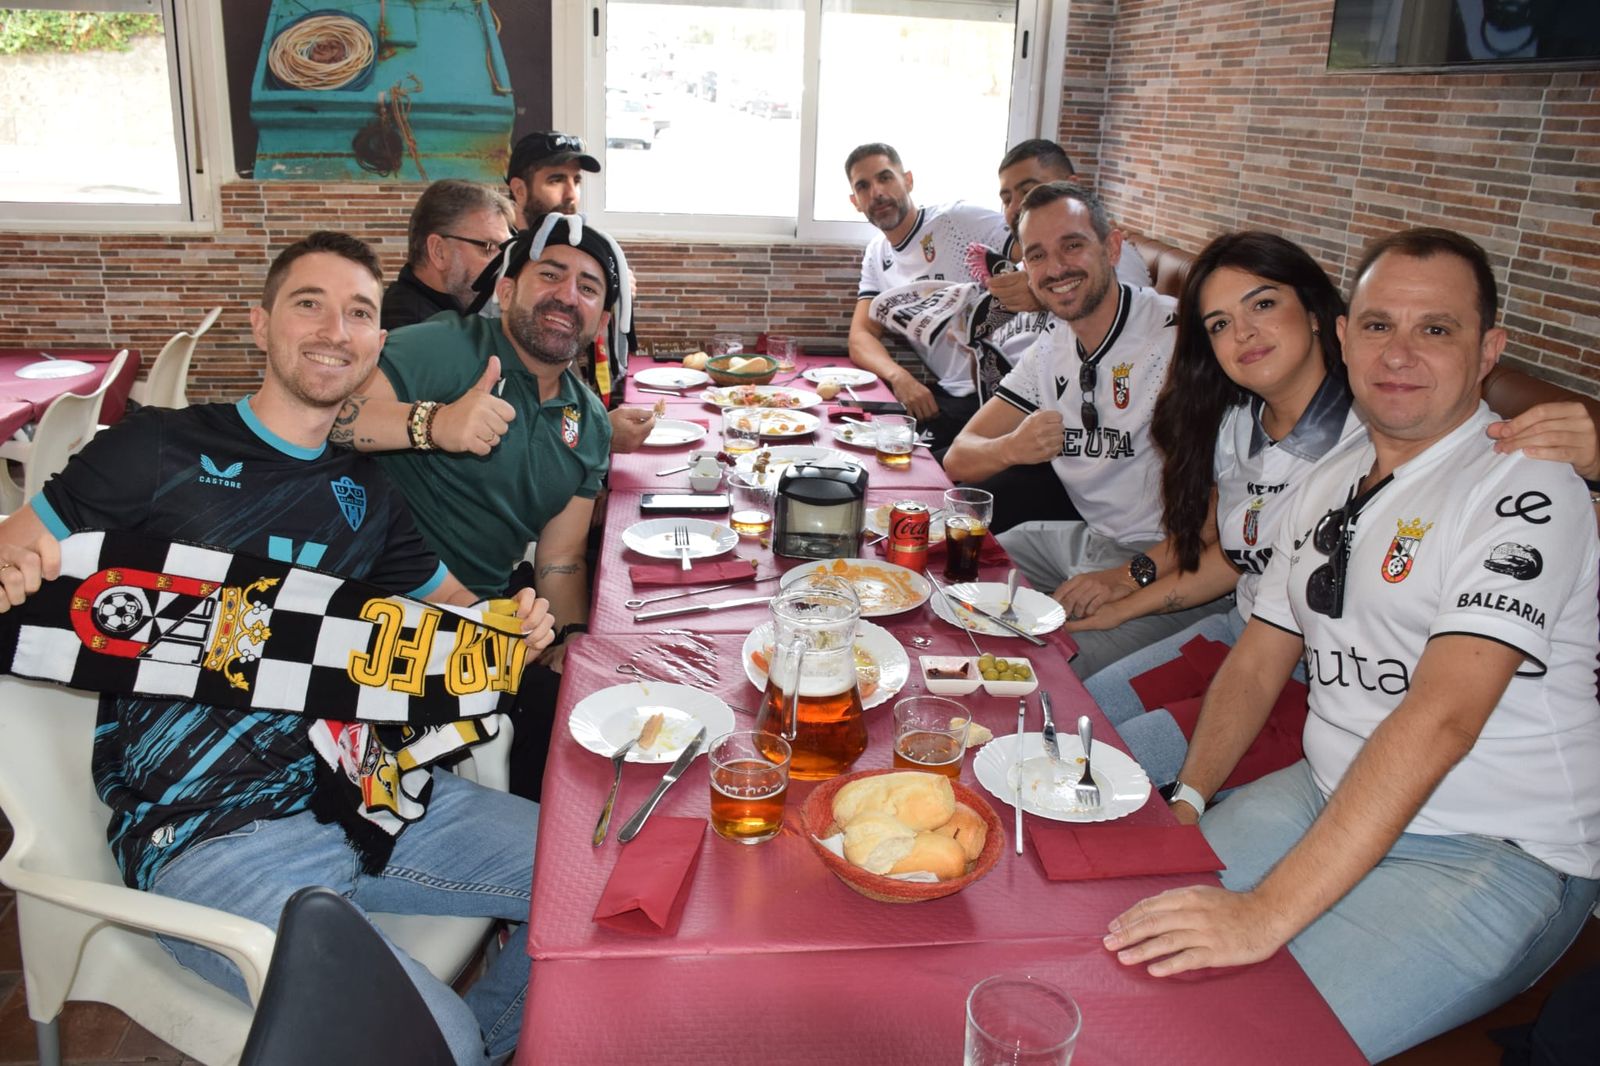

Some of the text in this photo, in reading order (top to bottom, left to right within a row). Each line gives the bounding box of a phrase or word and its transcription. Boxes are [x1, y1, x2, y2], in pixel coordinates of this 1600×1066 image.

[1057, 427, 1135, 460] EUTA
[199, 475, 242, 489] CASTORE
[1456, 592, 1546, 630] BALEARIA
[346, 597, 444, 698] FC
